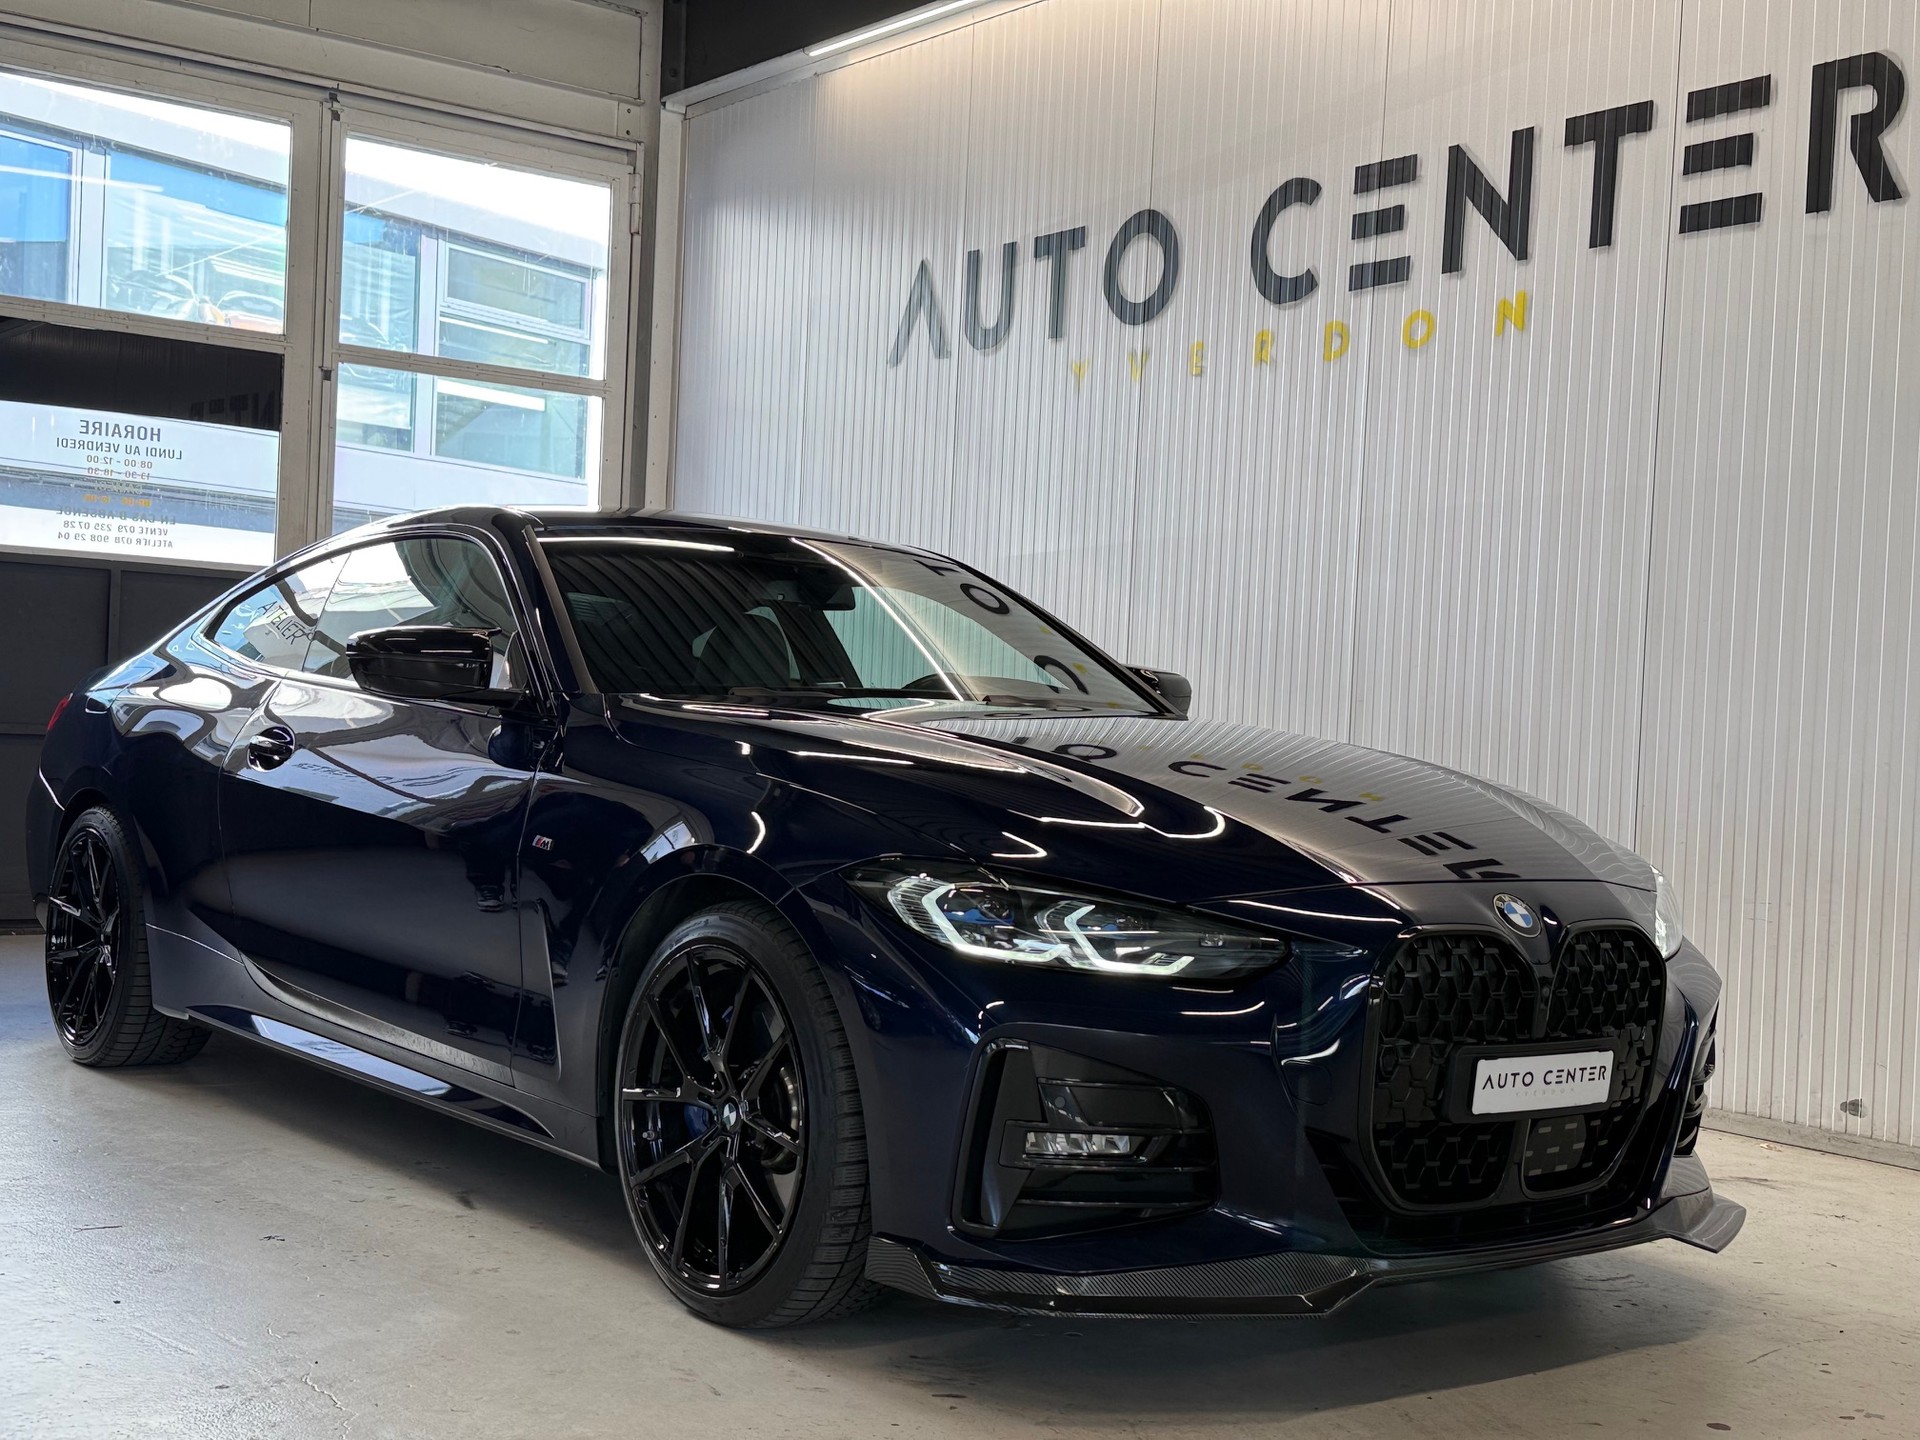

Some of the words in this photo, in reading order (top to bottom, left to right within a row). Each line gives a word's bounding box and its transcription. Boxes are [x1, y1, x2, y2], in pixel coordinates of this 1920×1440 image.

[886, 208, 1179, 367] AUTO
[1251, 51, 1905, 305] CENTER
[1072, 290, 1528, 387] YVERDON
[1482, 1071, 1534, 1090] AUTO
[1543, 1065, 1607, 1085] CENTER
